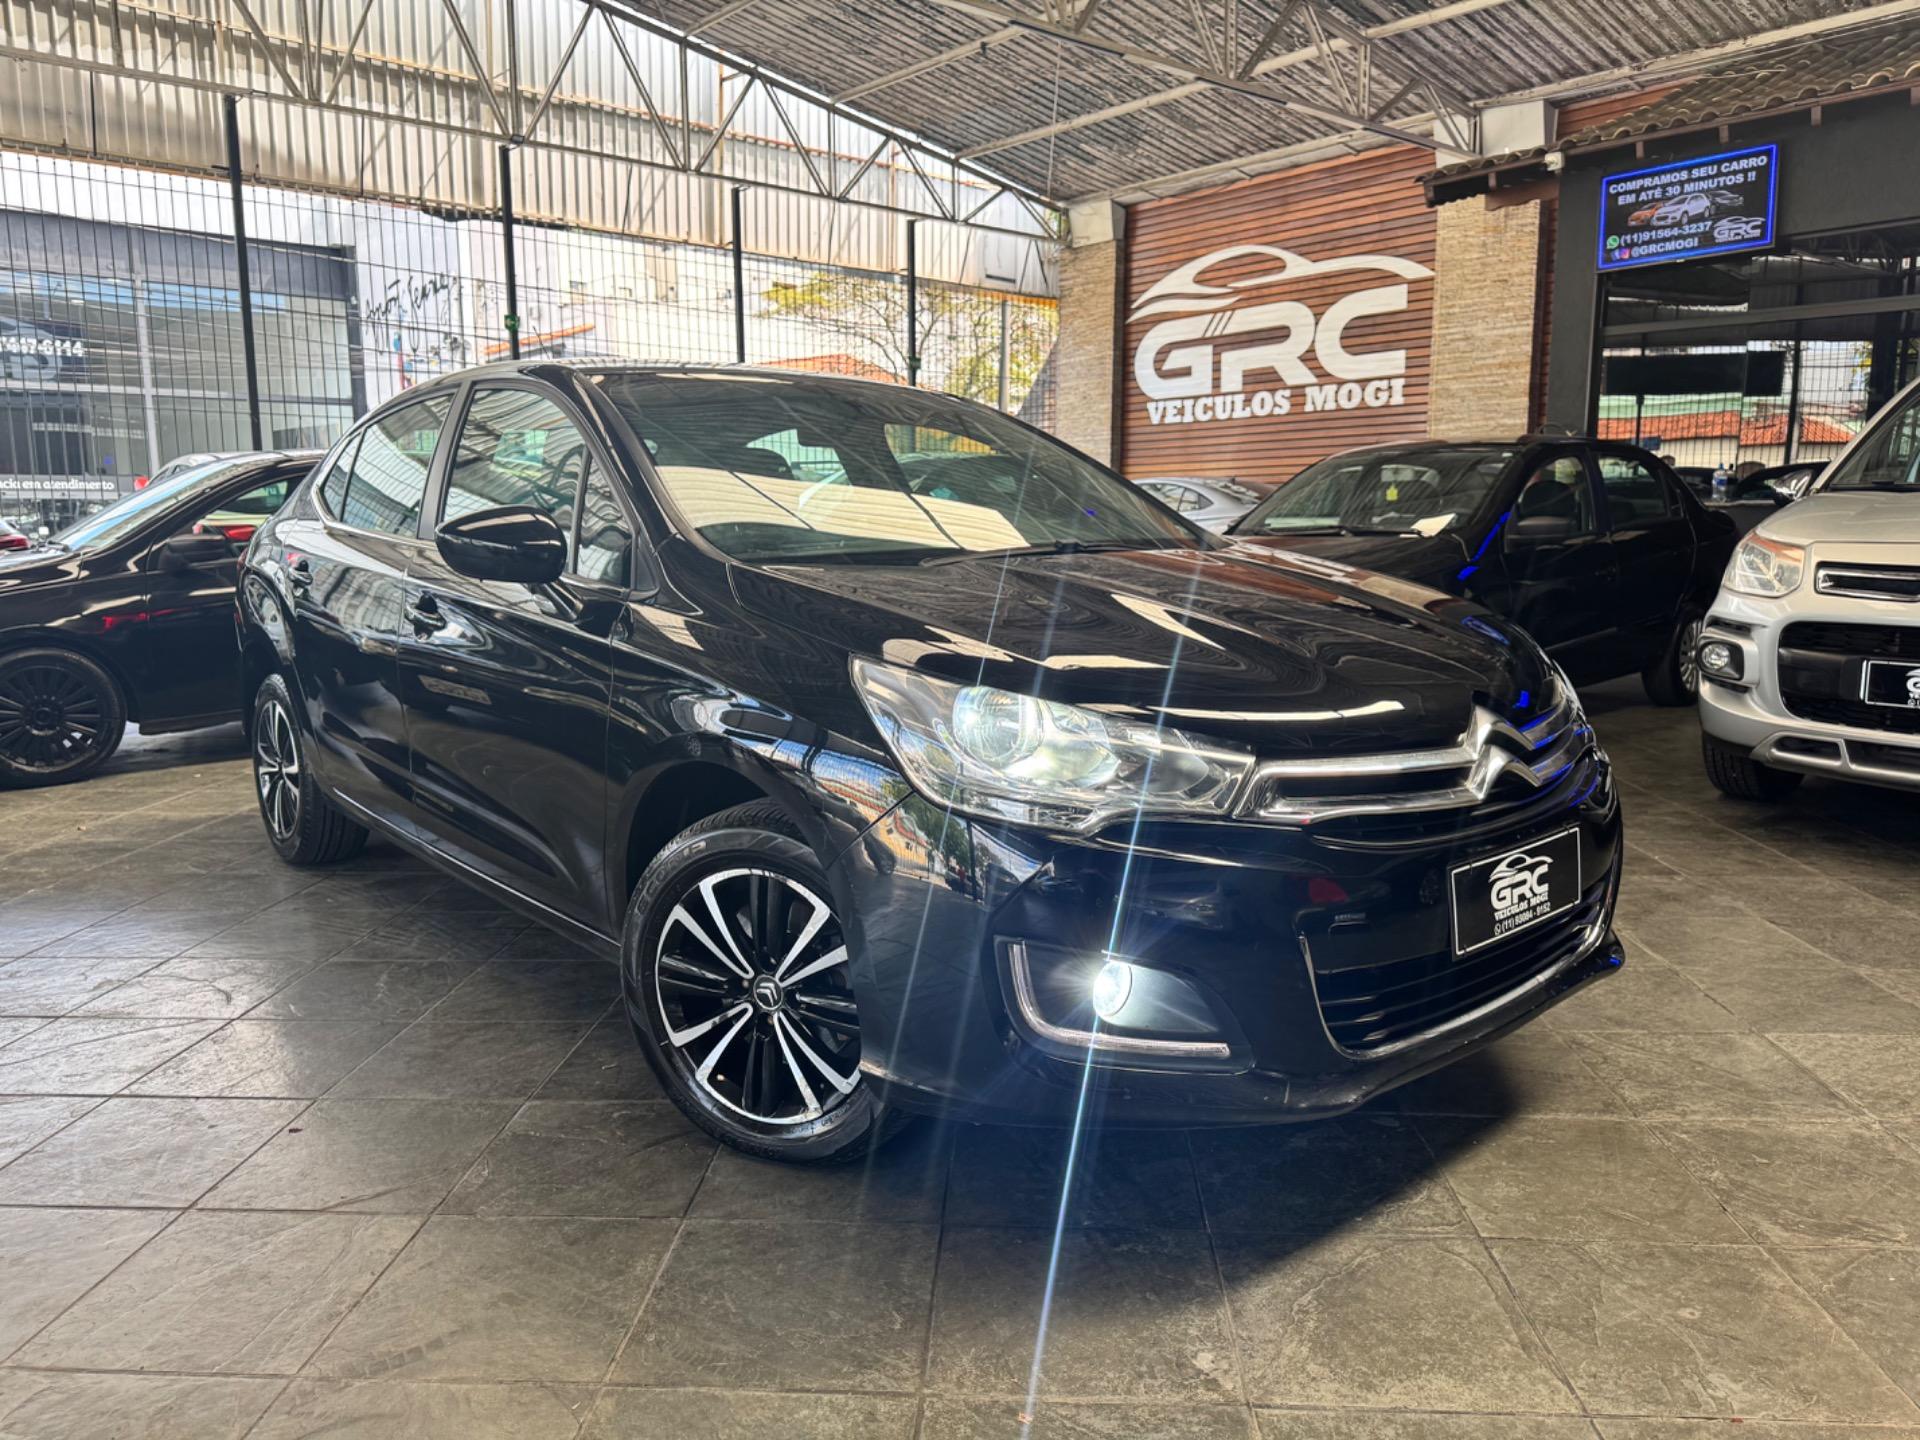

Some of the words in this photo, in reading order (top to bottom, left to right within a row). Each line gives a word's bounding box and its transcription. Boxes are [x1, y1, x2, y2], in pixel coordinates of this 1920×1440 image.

[1609, 170, 1688, 194] COMPRAMOS
[1691, 164, 1717, 179] SEU
[1721, 155, 1768, 173] CARRO
[1617, 193, 1637, 205] EM
[1638, 187, 1662, 202] ATÉ
[1666, 185, 1680, 197] 30
[1683, 173, 1744, 194] MINUTOS
[1713, 221, 1762, 239] GRC
[1631, 237, 1699, 258] @GRCMOGI
[1134, 283, 1409, 400] GRC
[1146, 388, 1292, 425] VEICULOS
[1303, 377, 1406, 412] MOGI
[22, 480, 41, 489] em
[1491, 863, 1549, 911] GRC
[1494, 900, 1528, 921] VEICULOS
